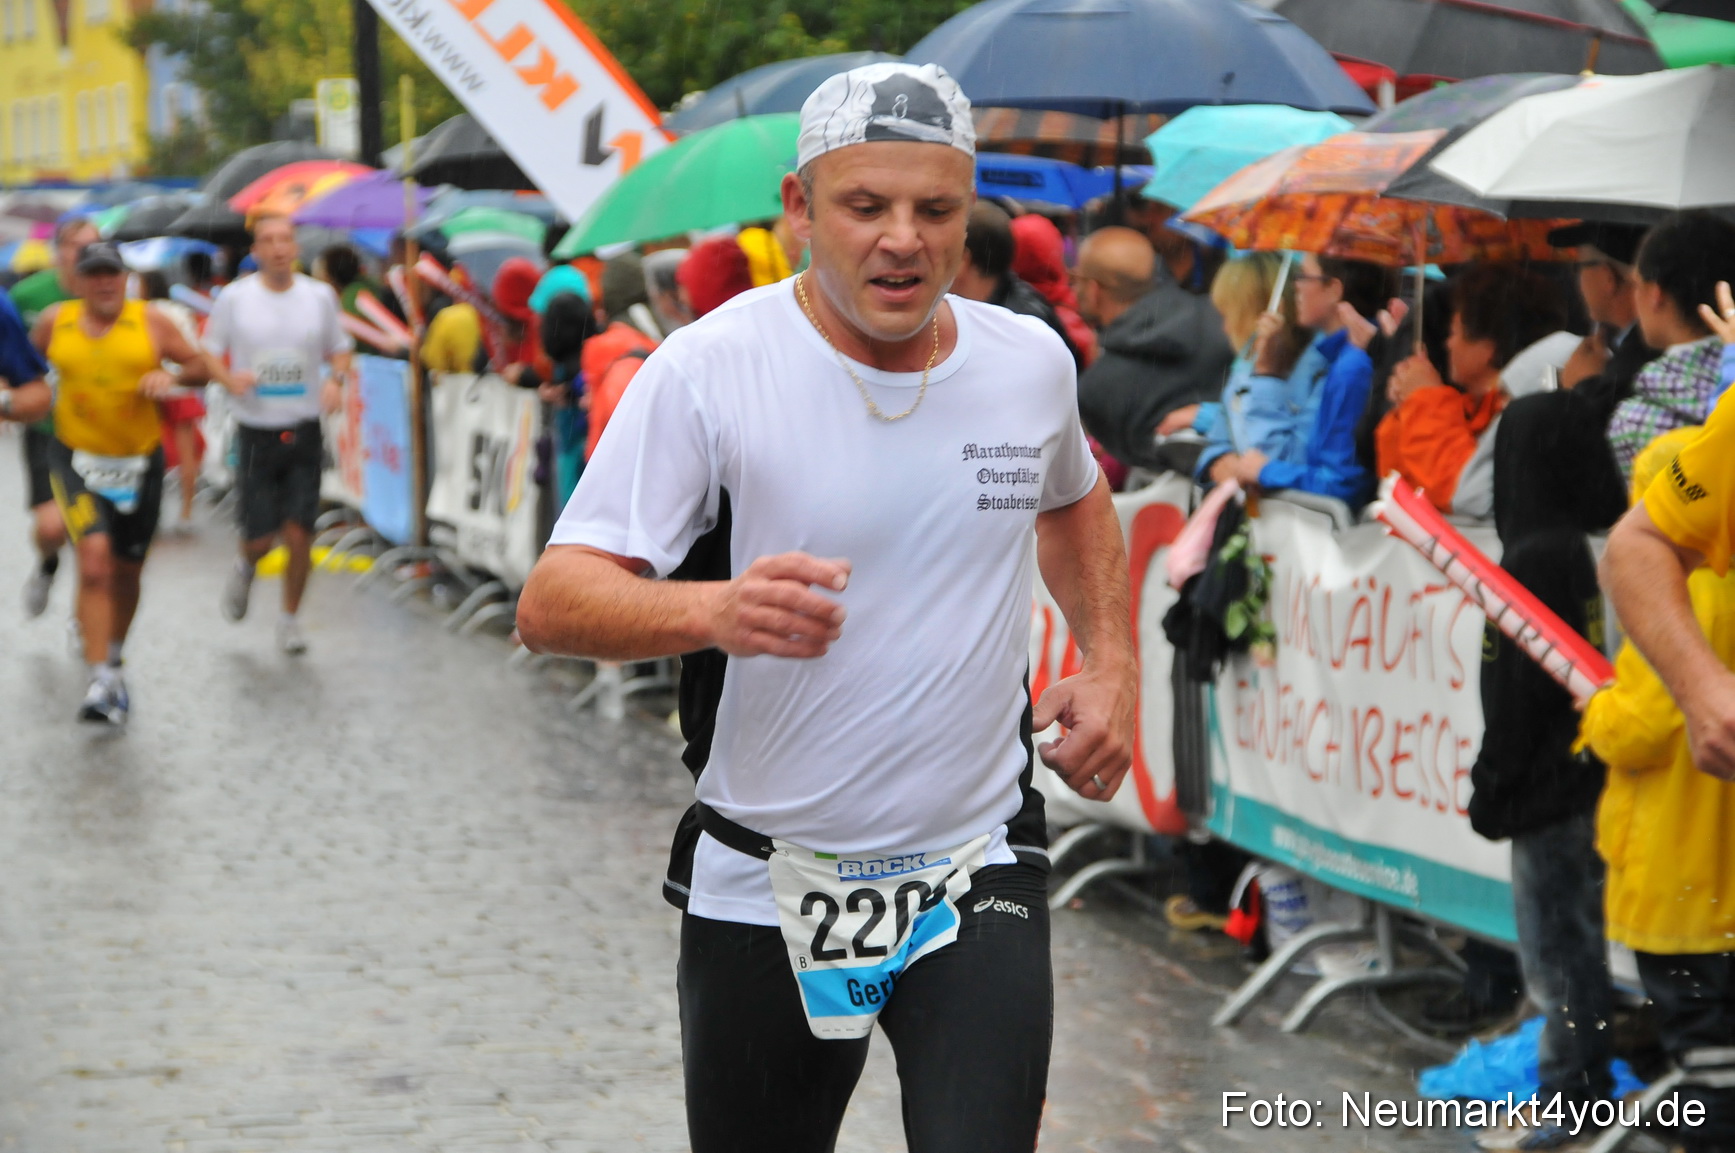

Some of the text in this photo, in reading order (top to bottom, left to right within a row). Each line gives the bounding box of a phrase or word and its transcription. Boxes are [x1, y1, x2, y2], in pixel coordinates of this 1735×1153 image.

[1419, 534, 1577, 684] AUSTRIA
[1351, 706, 1472, 818] BESSE
[839, 854, 926, 878] BOCK
[993, 899, 1029, 920] asics
[798, 956, 808, 969] B
